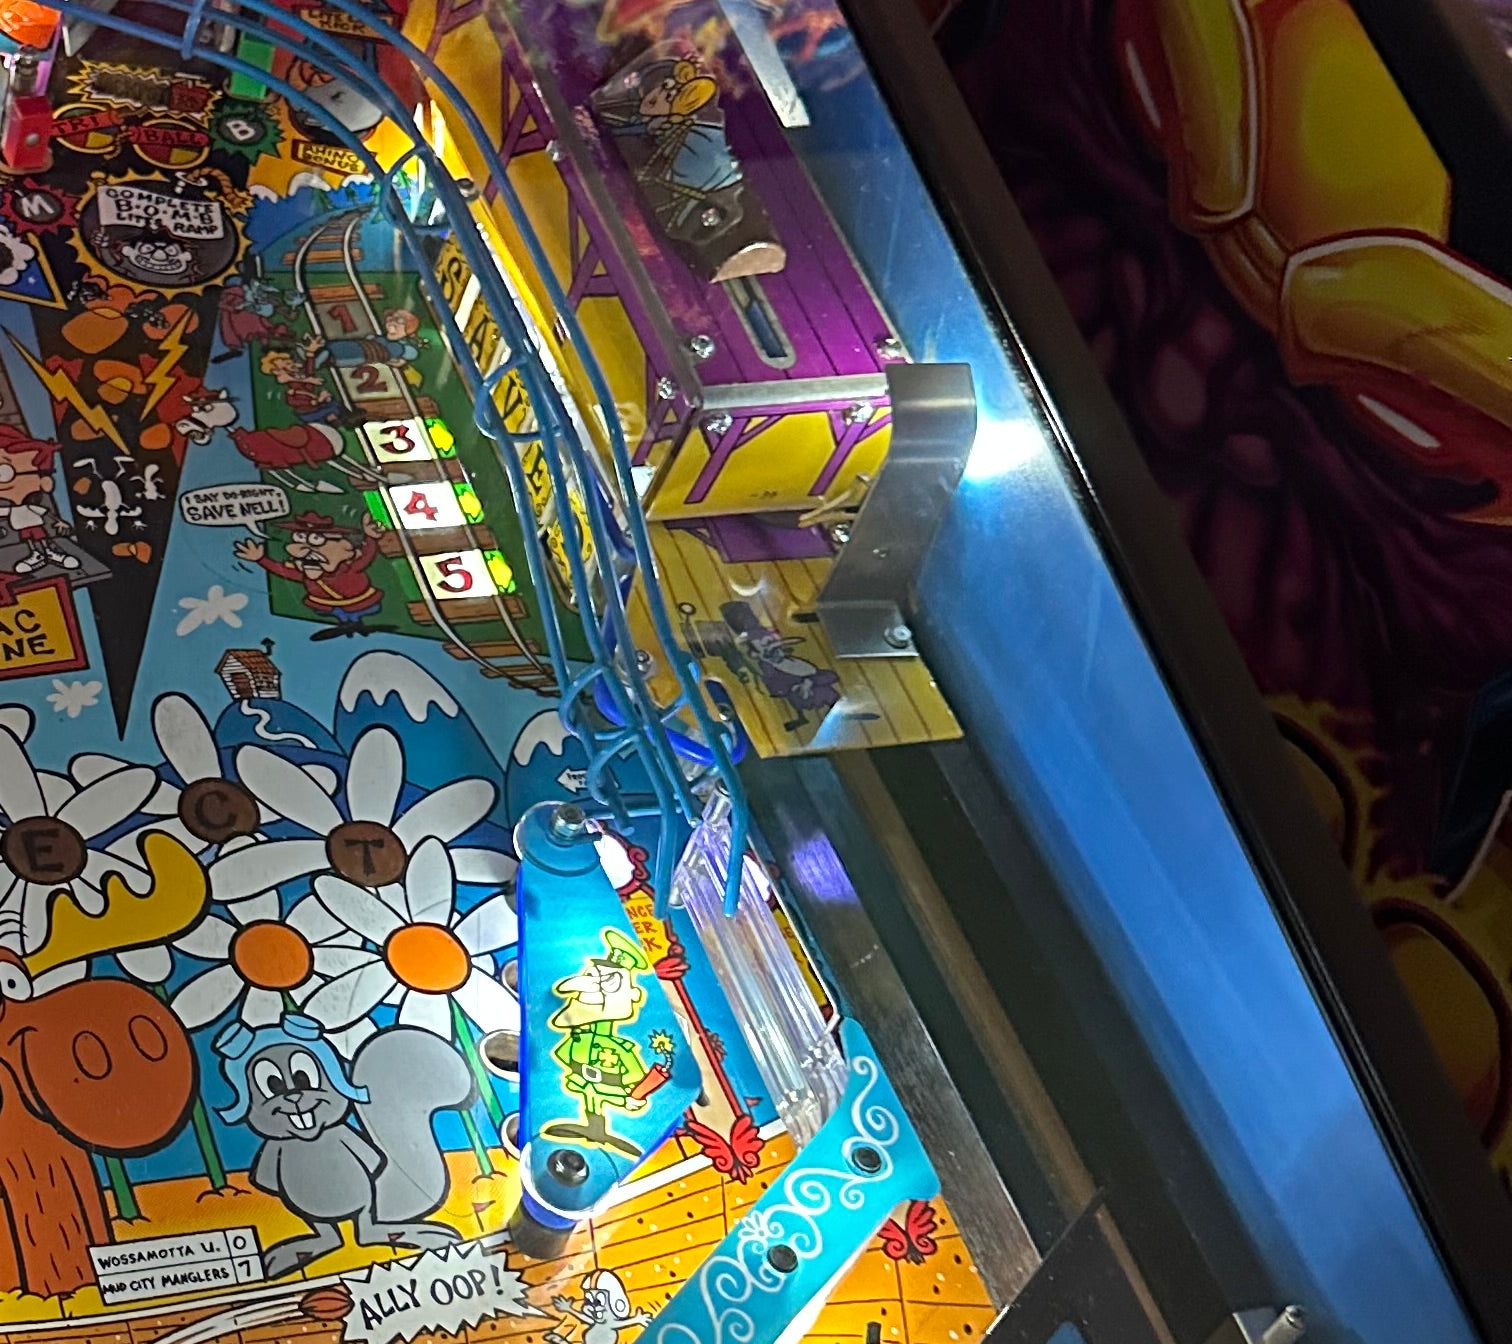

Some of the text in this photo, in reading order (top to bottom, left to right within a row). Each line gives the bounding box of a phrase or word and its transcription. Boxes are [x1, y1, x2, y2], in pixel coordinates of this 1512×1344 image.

[52, 114, 101, 139] TRI
[143, 129, 204, 146] BALL
[225, 119, 257, 142] B
[18, 193, 58, 222] M
[105, 187, 216, 216] COMPLETE
[173, 222, 219, 236] RAMP
[326, 304, 359, 335] 1
[349, 365, 389, 394] 2
[378, 424, 417, 456] 3
[186, 499, 286, 522] SAVE NELL!
[193, 492, 219, 504] SAY
[402, 488, 440, 522] 4
[433, 557, 473, 595] 5
[22, 829, 65, 872] E
[193, 791, 239, 833] C
[343, 836, 386, 875] T
[97, 1245, 195, 1271] WOSSAMOTTA
[200, 1241, 222, 1254] U.
[101, 1259, 252, 1296] MUD CITY MANGLERS 7
[360, 1264, 506, 1331] ALLY OOP!
